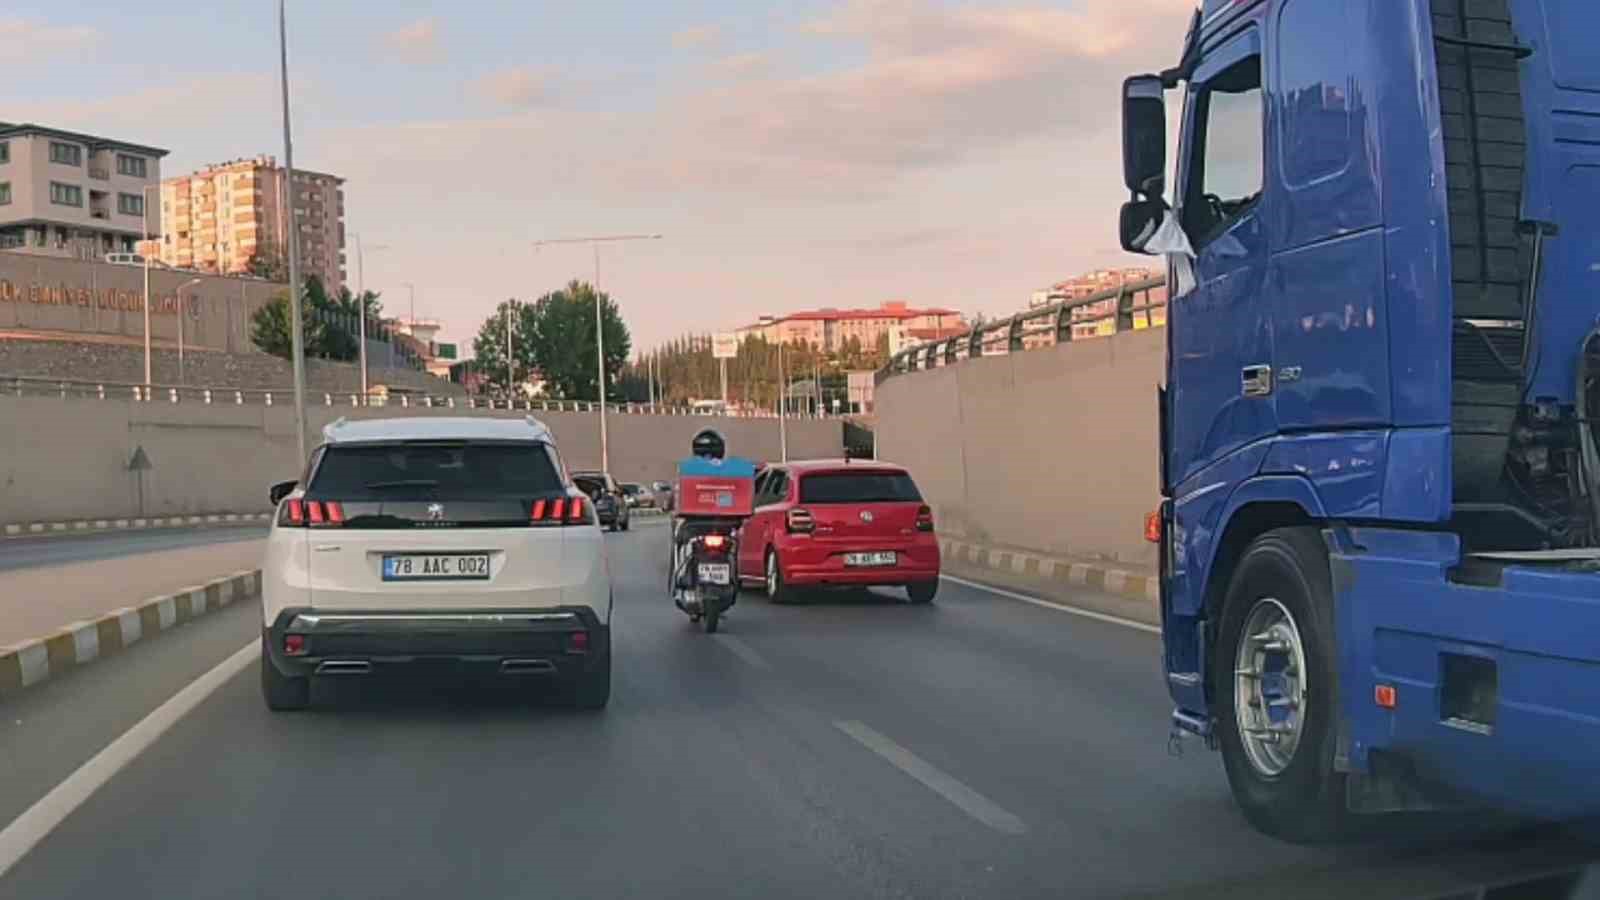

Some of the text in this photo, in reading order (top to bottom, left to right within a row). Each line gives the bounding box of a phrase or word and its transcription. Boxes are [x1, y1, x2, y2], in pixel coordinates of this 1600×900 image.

[392, 558, 486, 574] 78 AAC 002
